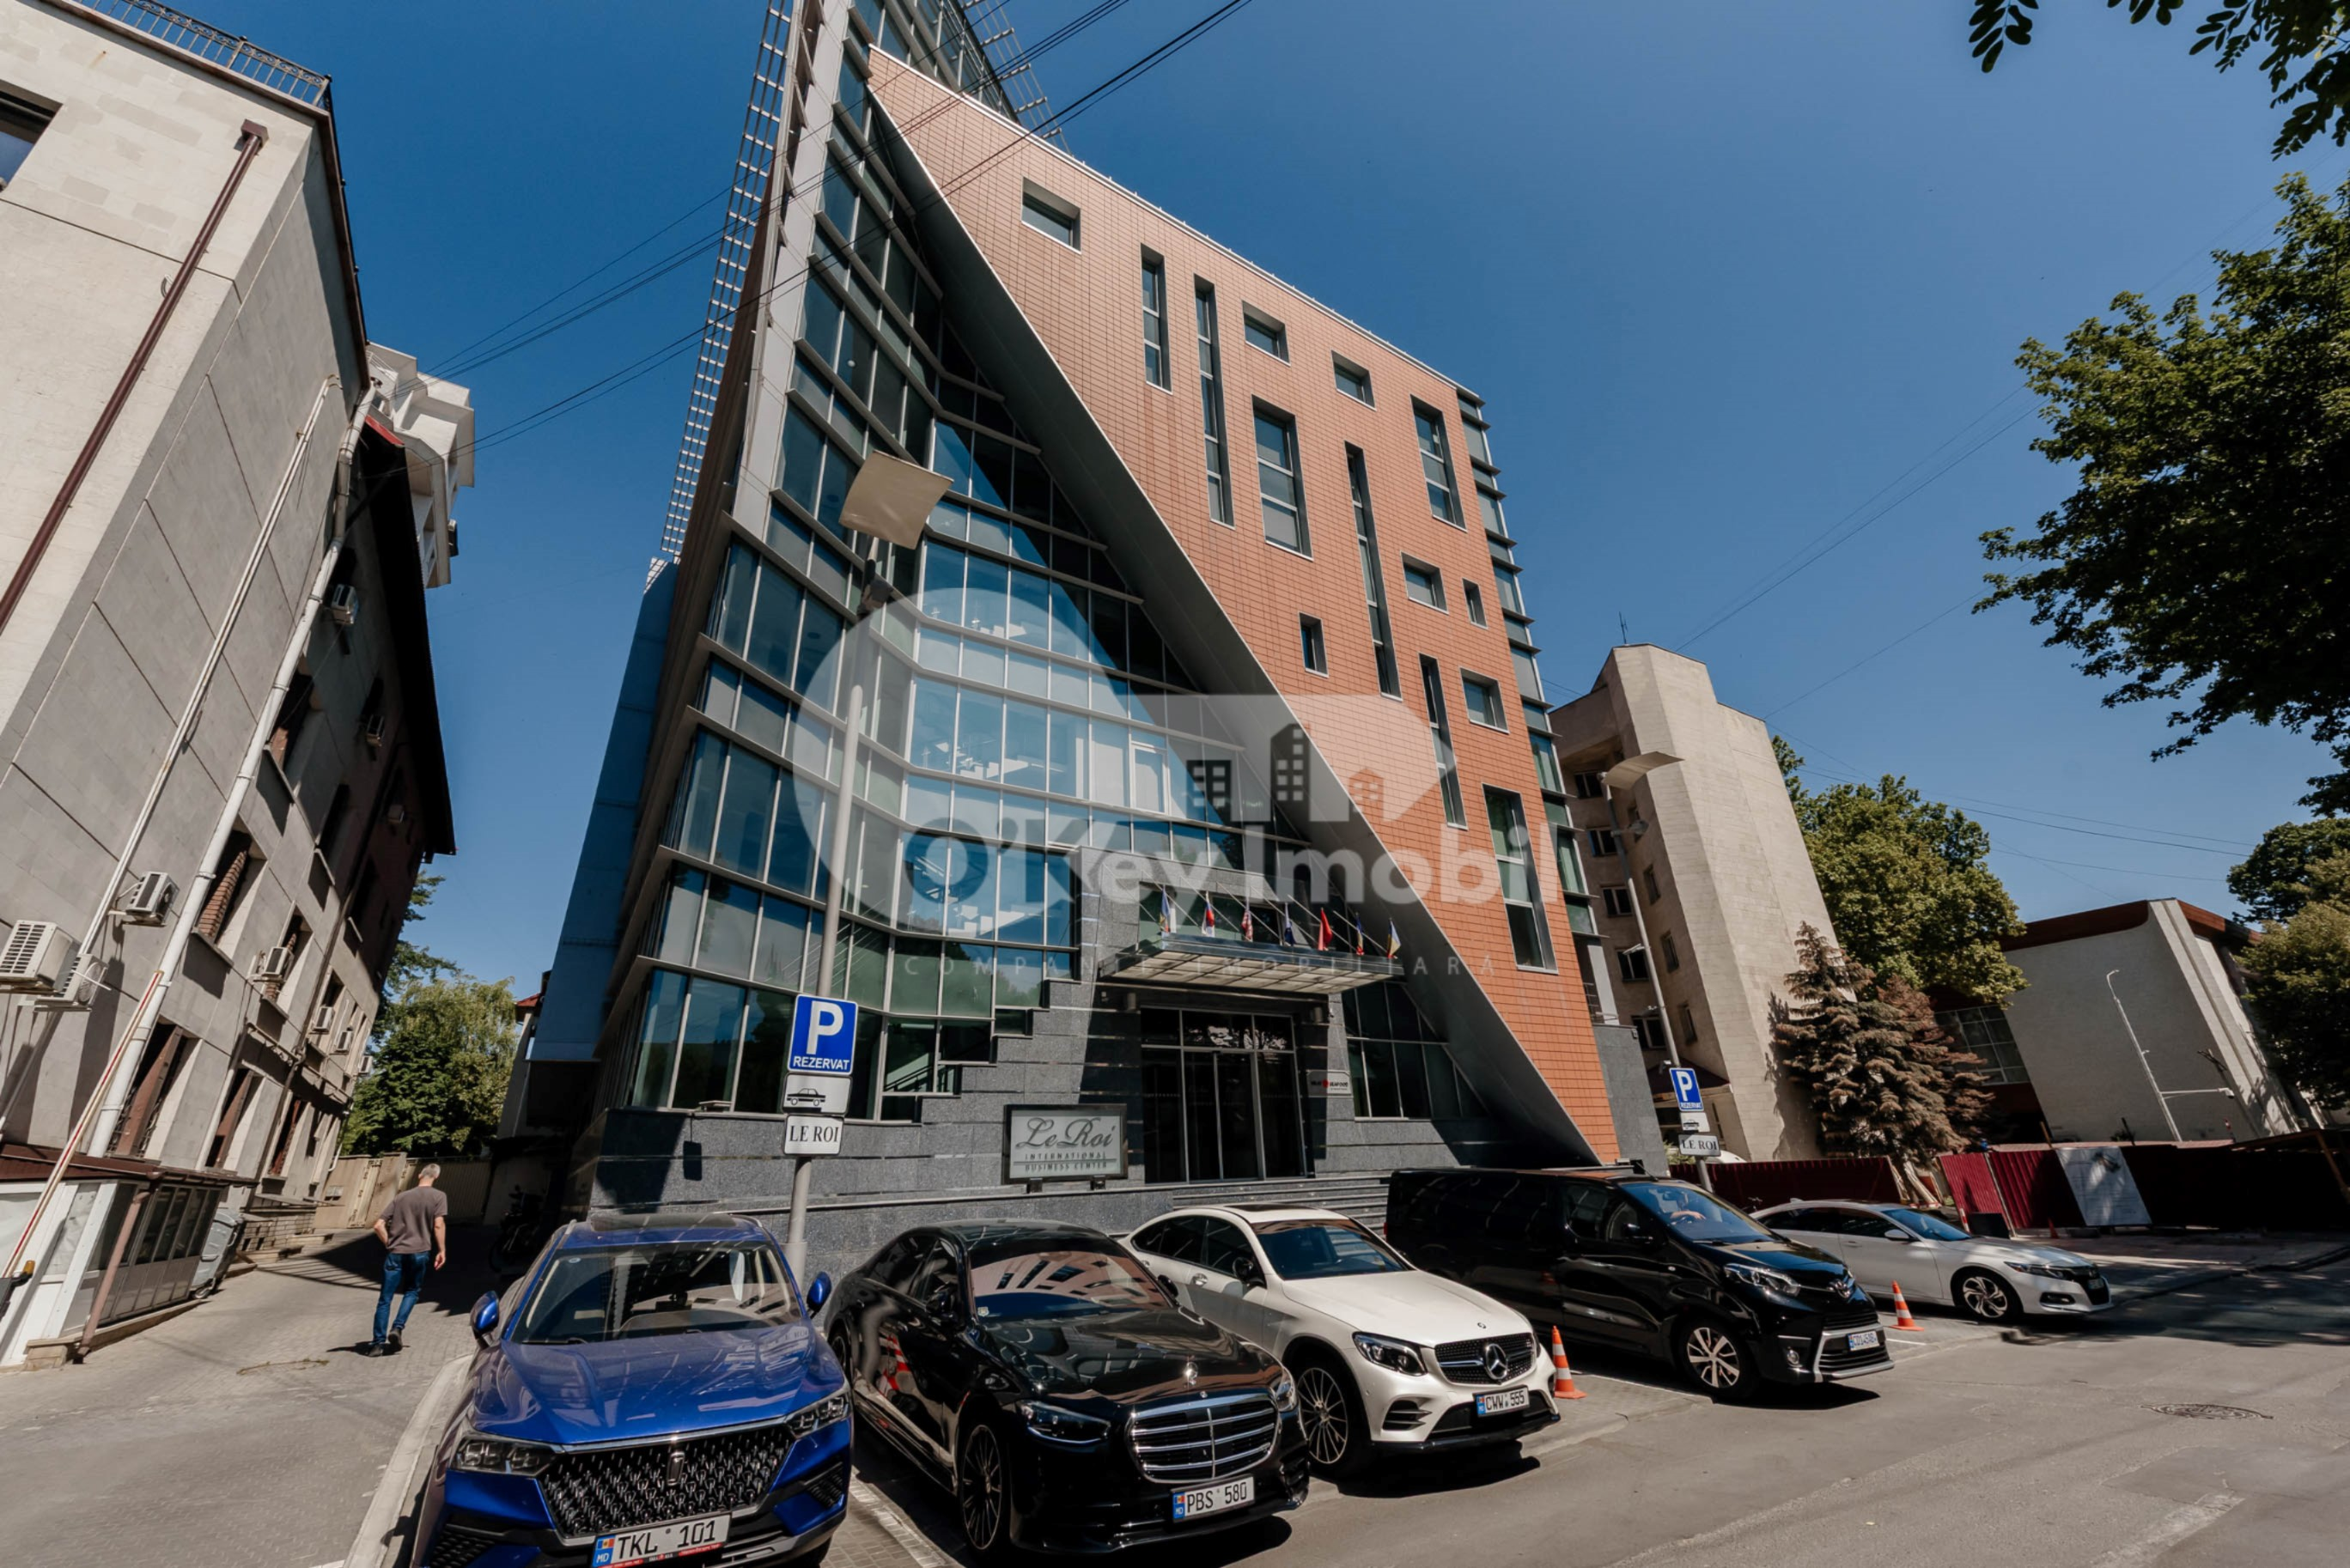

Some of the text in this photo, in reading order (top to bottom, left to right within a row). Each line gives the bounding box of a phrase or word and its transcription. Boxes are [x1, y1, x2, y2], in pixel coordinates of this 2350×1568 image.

[806, 1000, 844, 1055] P
[793, 1055, 850, 1071] REZERVAT
[1676, 1071, 1693, 1102] P
[789, 1126, 840, 1143] LE ROI
[1015, 1116, 1116, 1148] Le Roi
[1682, 1140, 1718, 1151] LE ROI
[1025, 1152, 1106, 1160] INTERNATIONAL
[1025, 1163, 1069, 1171] BUSINESS
[1485, 1390, 1525, 1411] CWW 555
[1186, 1481, 1247, 1513] PBS 580
[618, 1532, 658, 1559] TKL
[677, 1520, 715, 1548] 101
[596, 1553, 609, 1564] MD
